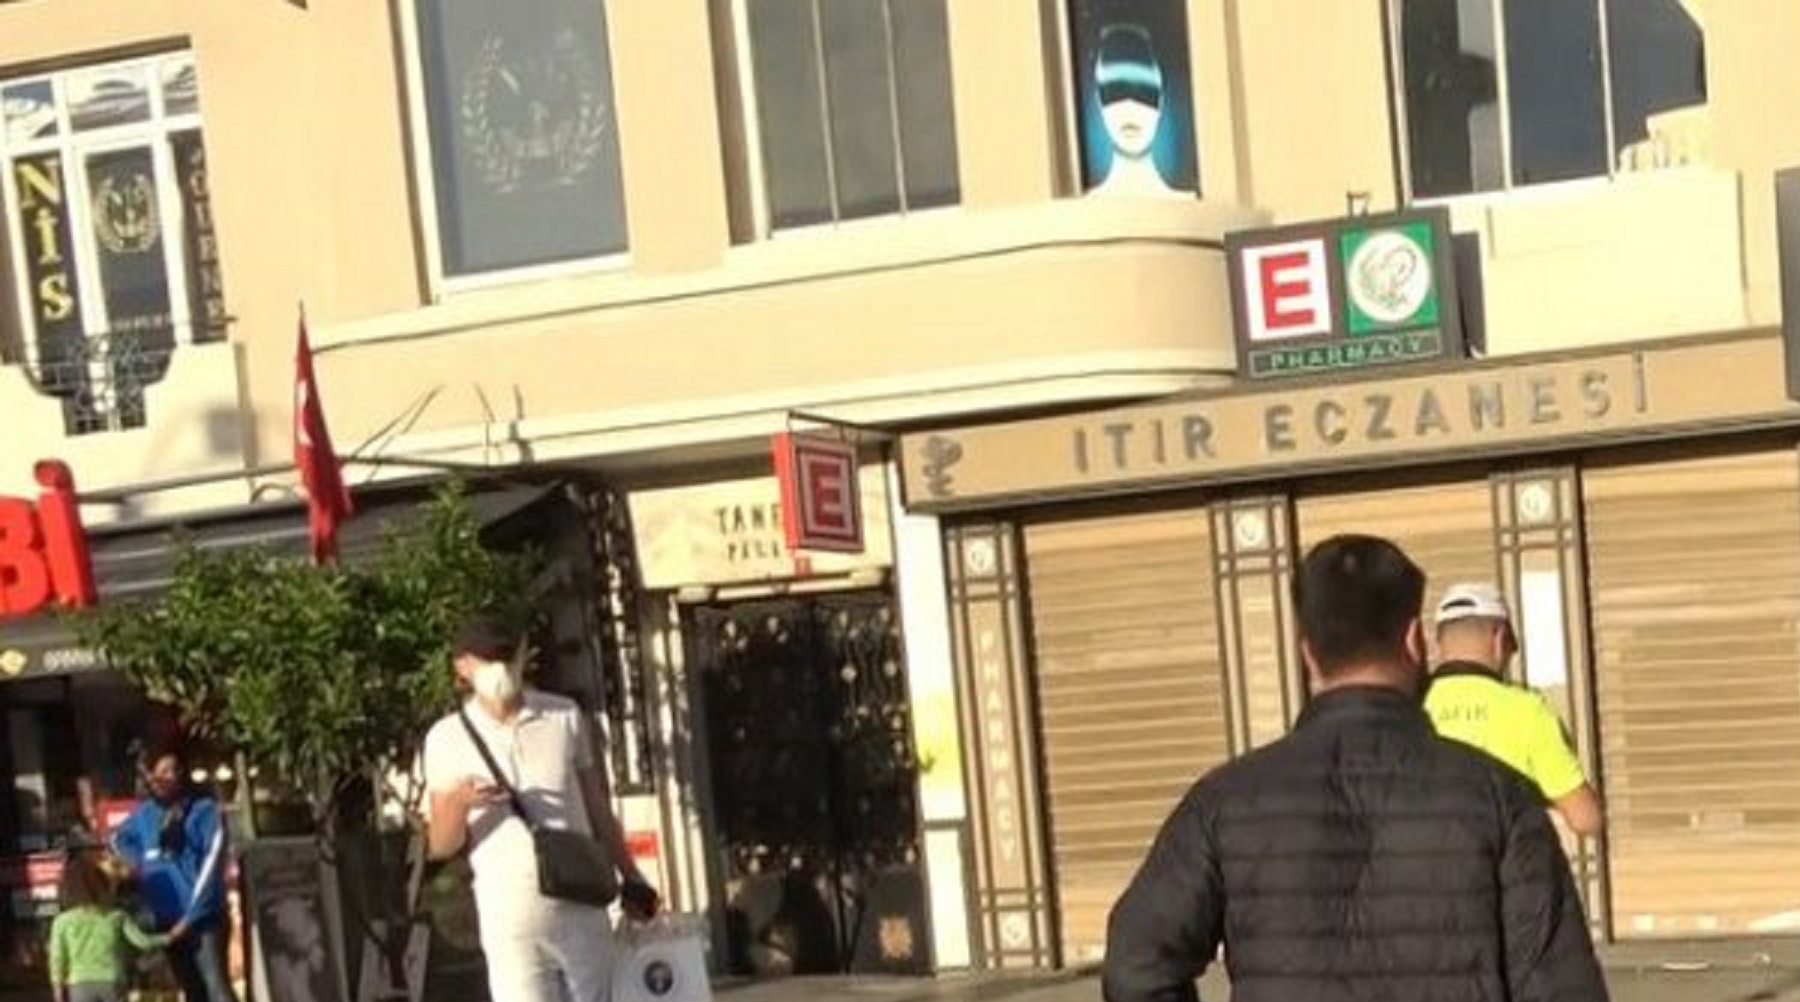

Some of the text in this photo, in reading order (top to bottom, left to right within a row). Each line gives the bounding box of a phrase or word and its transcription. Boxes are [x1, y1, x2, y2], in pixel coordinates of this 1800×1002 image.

[1258, 251, 1316, 331] E
[1269, 335, 1424, 370] PHARMACY
[1072, 411, 1216, 475] ITIR
[807, 458, 847, 529] E
[980, 628, 1018, 862] PHARMACY
